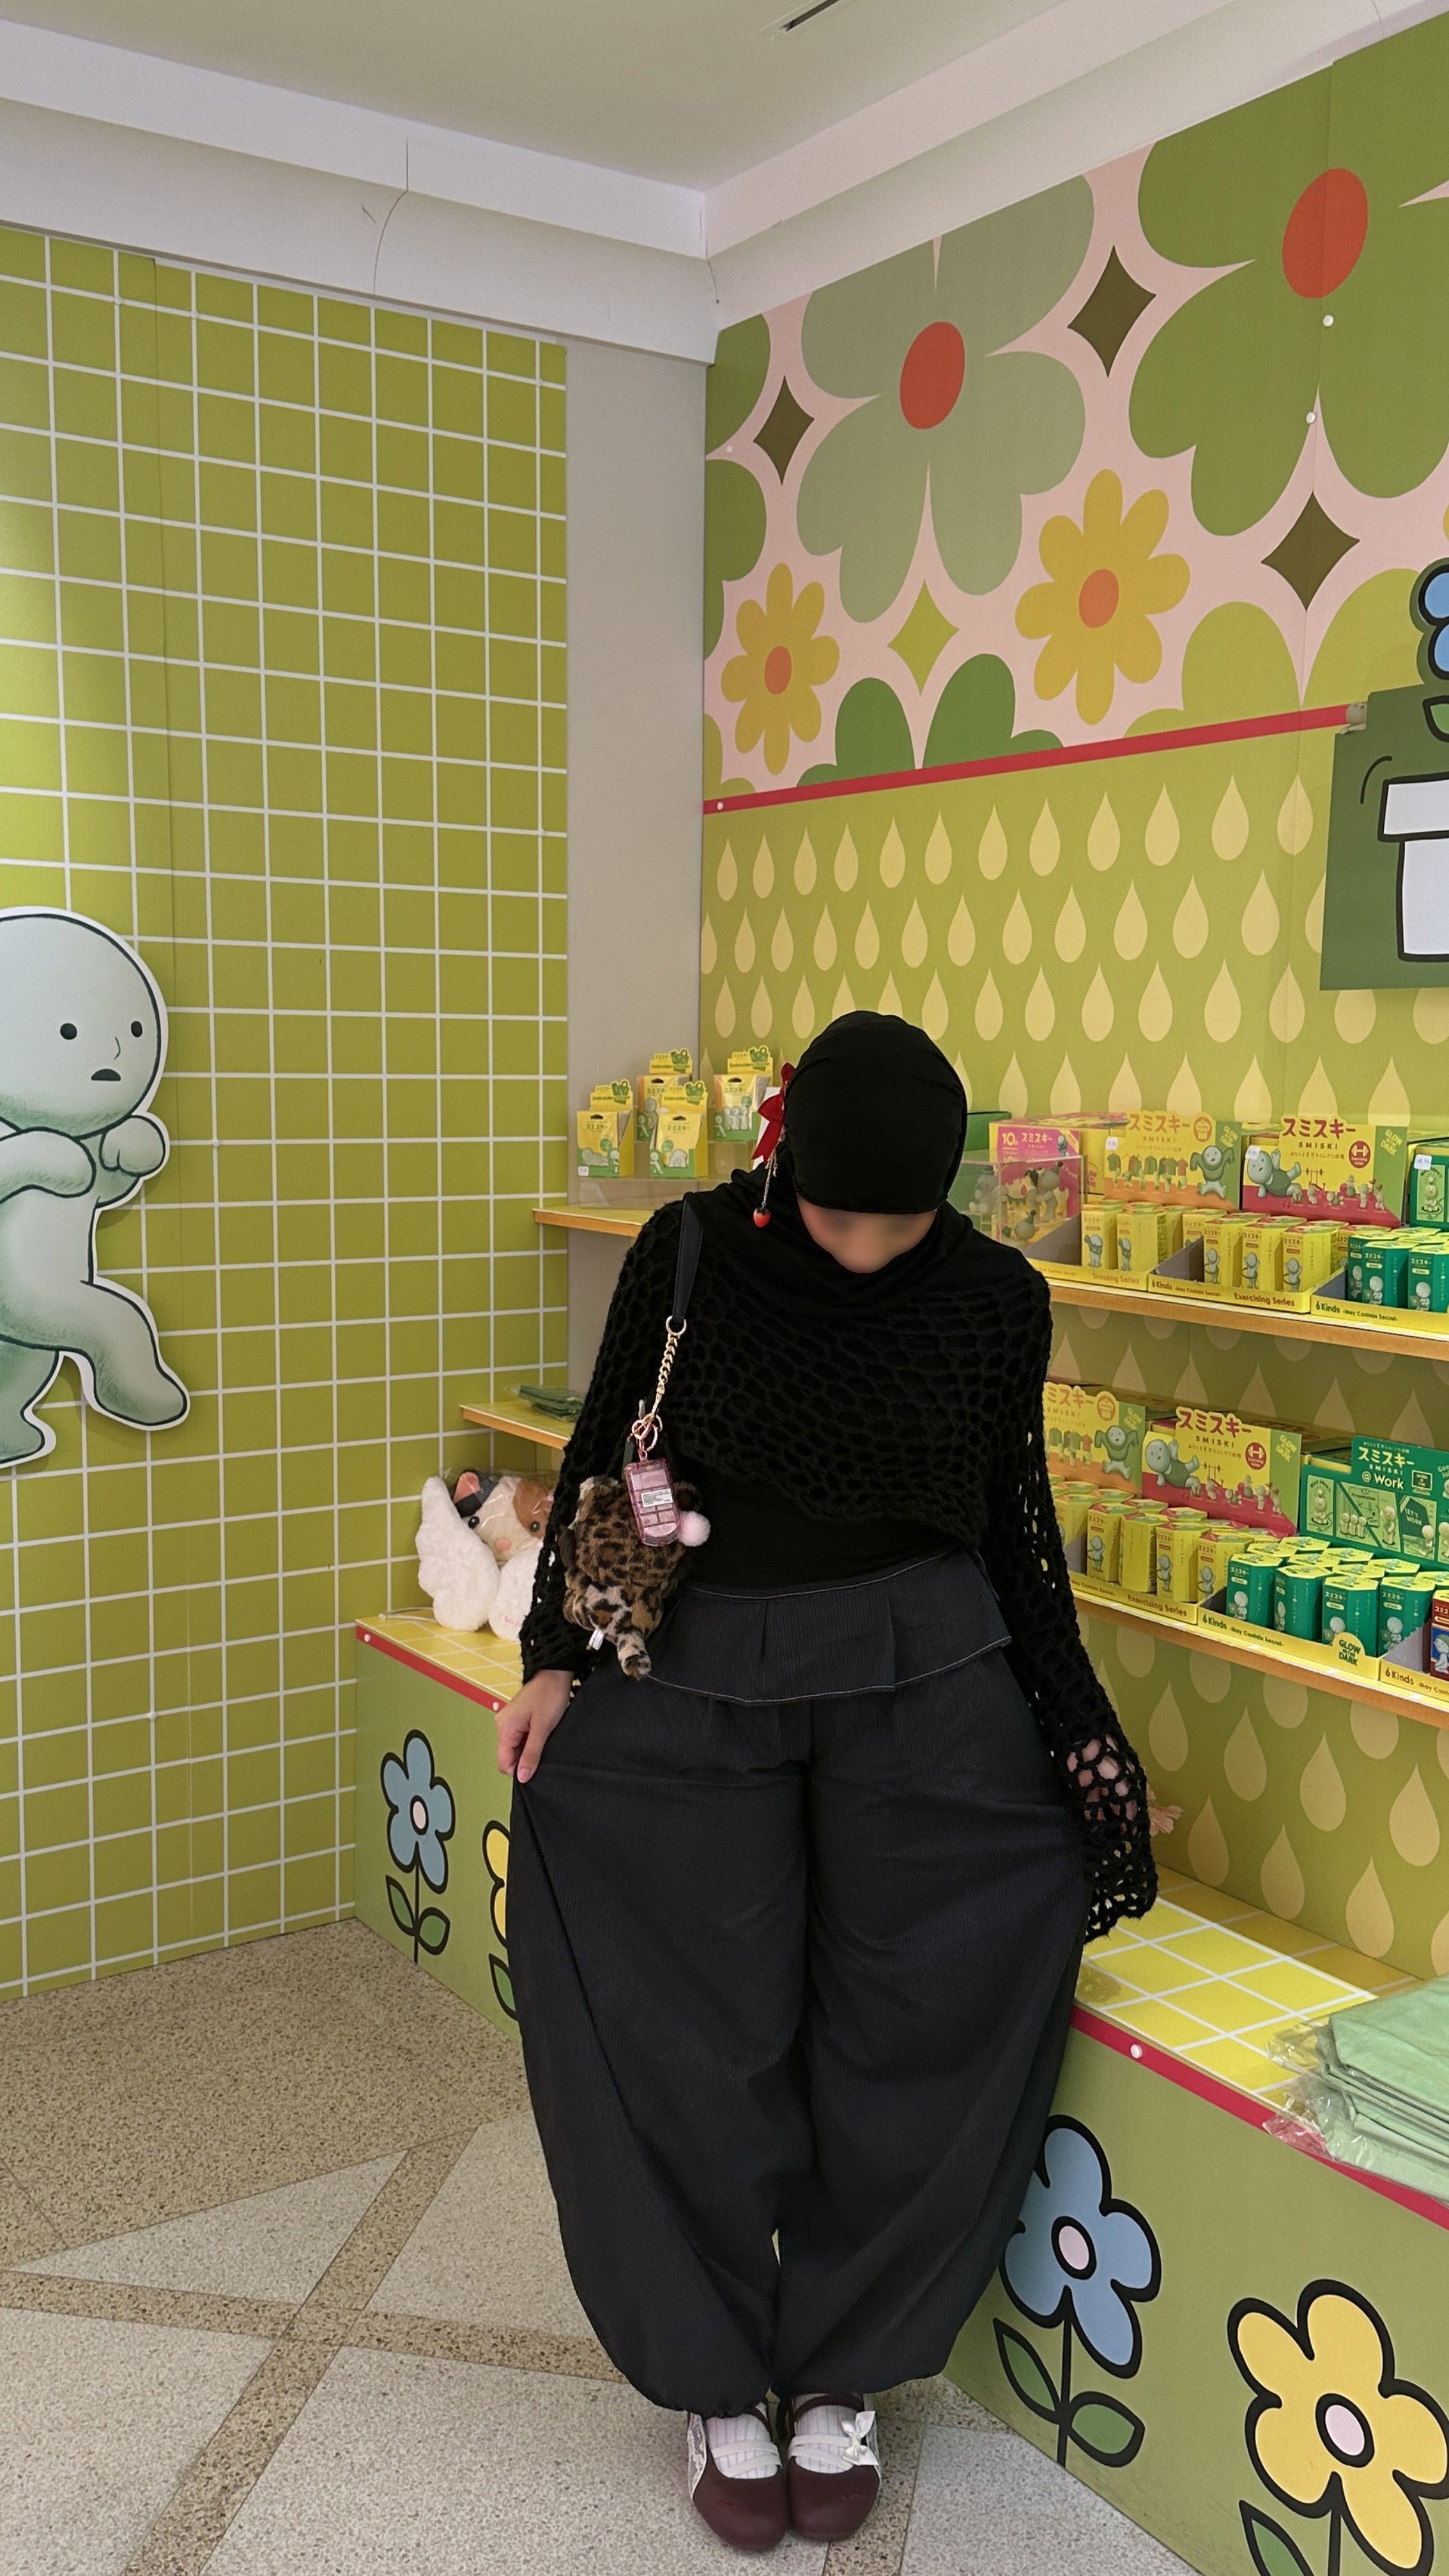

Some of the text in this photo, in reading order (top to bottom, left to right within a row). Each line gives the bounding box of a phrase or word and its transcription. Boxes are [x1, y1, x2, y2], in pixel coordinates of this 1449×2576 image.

[1129, 1114, 1190, 1133] スミスキー
[1282, 1118, 1356, 1139] スミスキー
[1021, 1132, 1054, 1144] スミスキー
[1385, 1128, 1403, 1145] GLOW
[1298, 1141, 1338, 1149] SMISKI
[1156, 1281, 1172, 1290] Kinds
[1234, 1293, 1295, 1307] Exercising Series
[1315, 1301, 1320, 1310] 6
[1321, 1302, 1340, 1314] Kinds
[1047, 1386, 1094, 1409] ミスキー
[1179, 1410, 1252, 1438] スミスキー
[1195, 1435, 1234, 1448] SMISKI
[1358, 1446, 1414, 1468] スミスキー
[1368, 1464, 1403, 1475] SMISKI
[1374, 1473, 1404, 1490] Work
[1127, 1594, 1187, 1617] Exercising Series
[1202, 1614, 1208, 1623] 6
[1208, 1616, 1227, 1630] Kinds
[1339, 1639, 1361, 1653] GLOW
[1338, 1652, 1358, 1667] DARK
[1385, 1667, 1390, 1677] 6
[1392, 1671, 1414, 1685] Kinds
